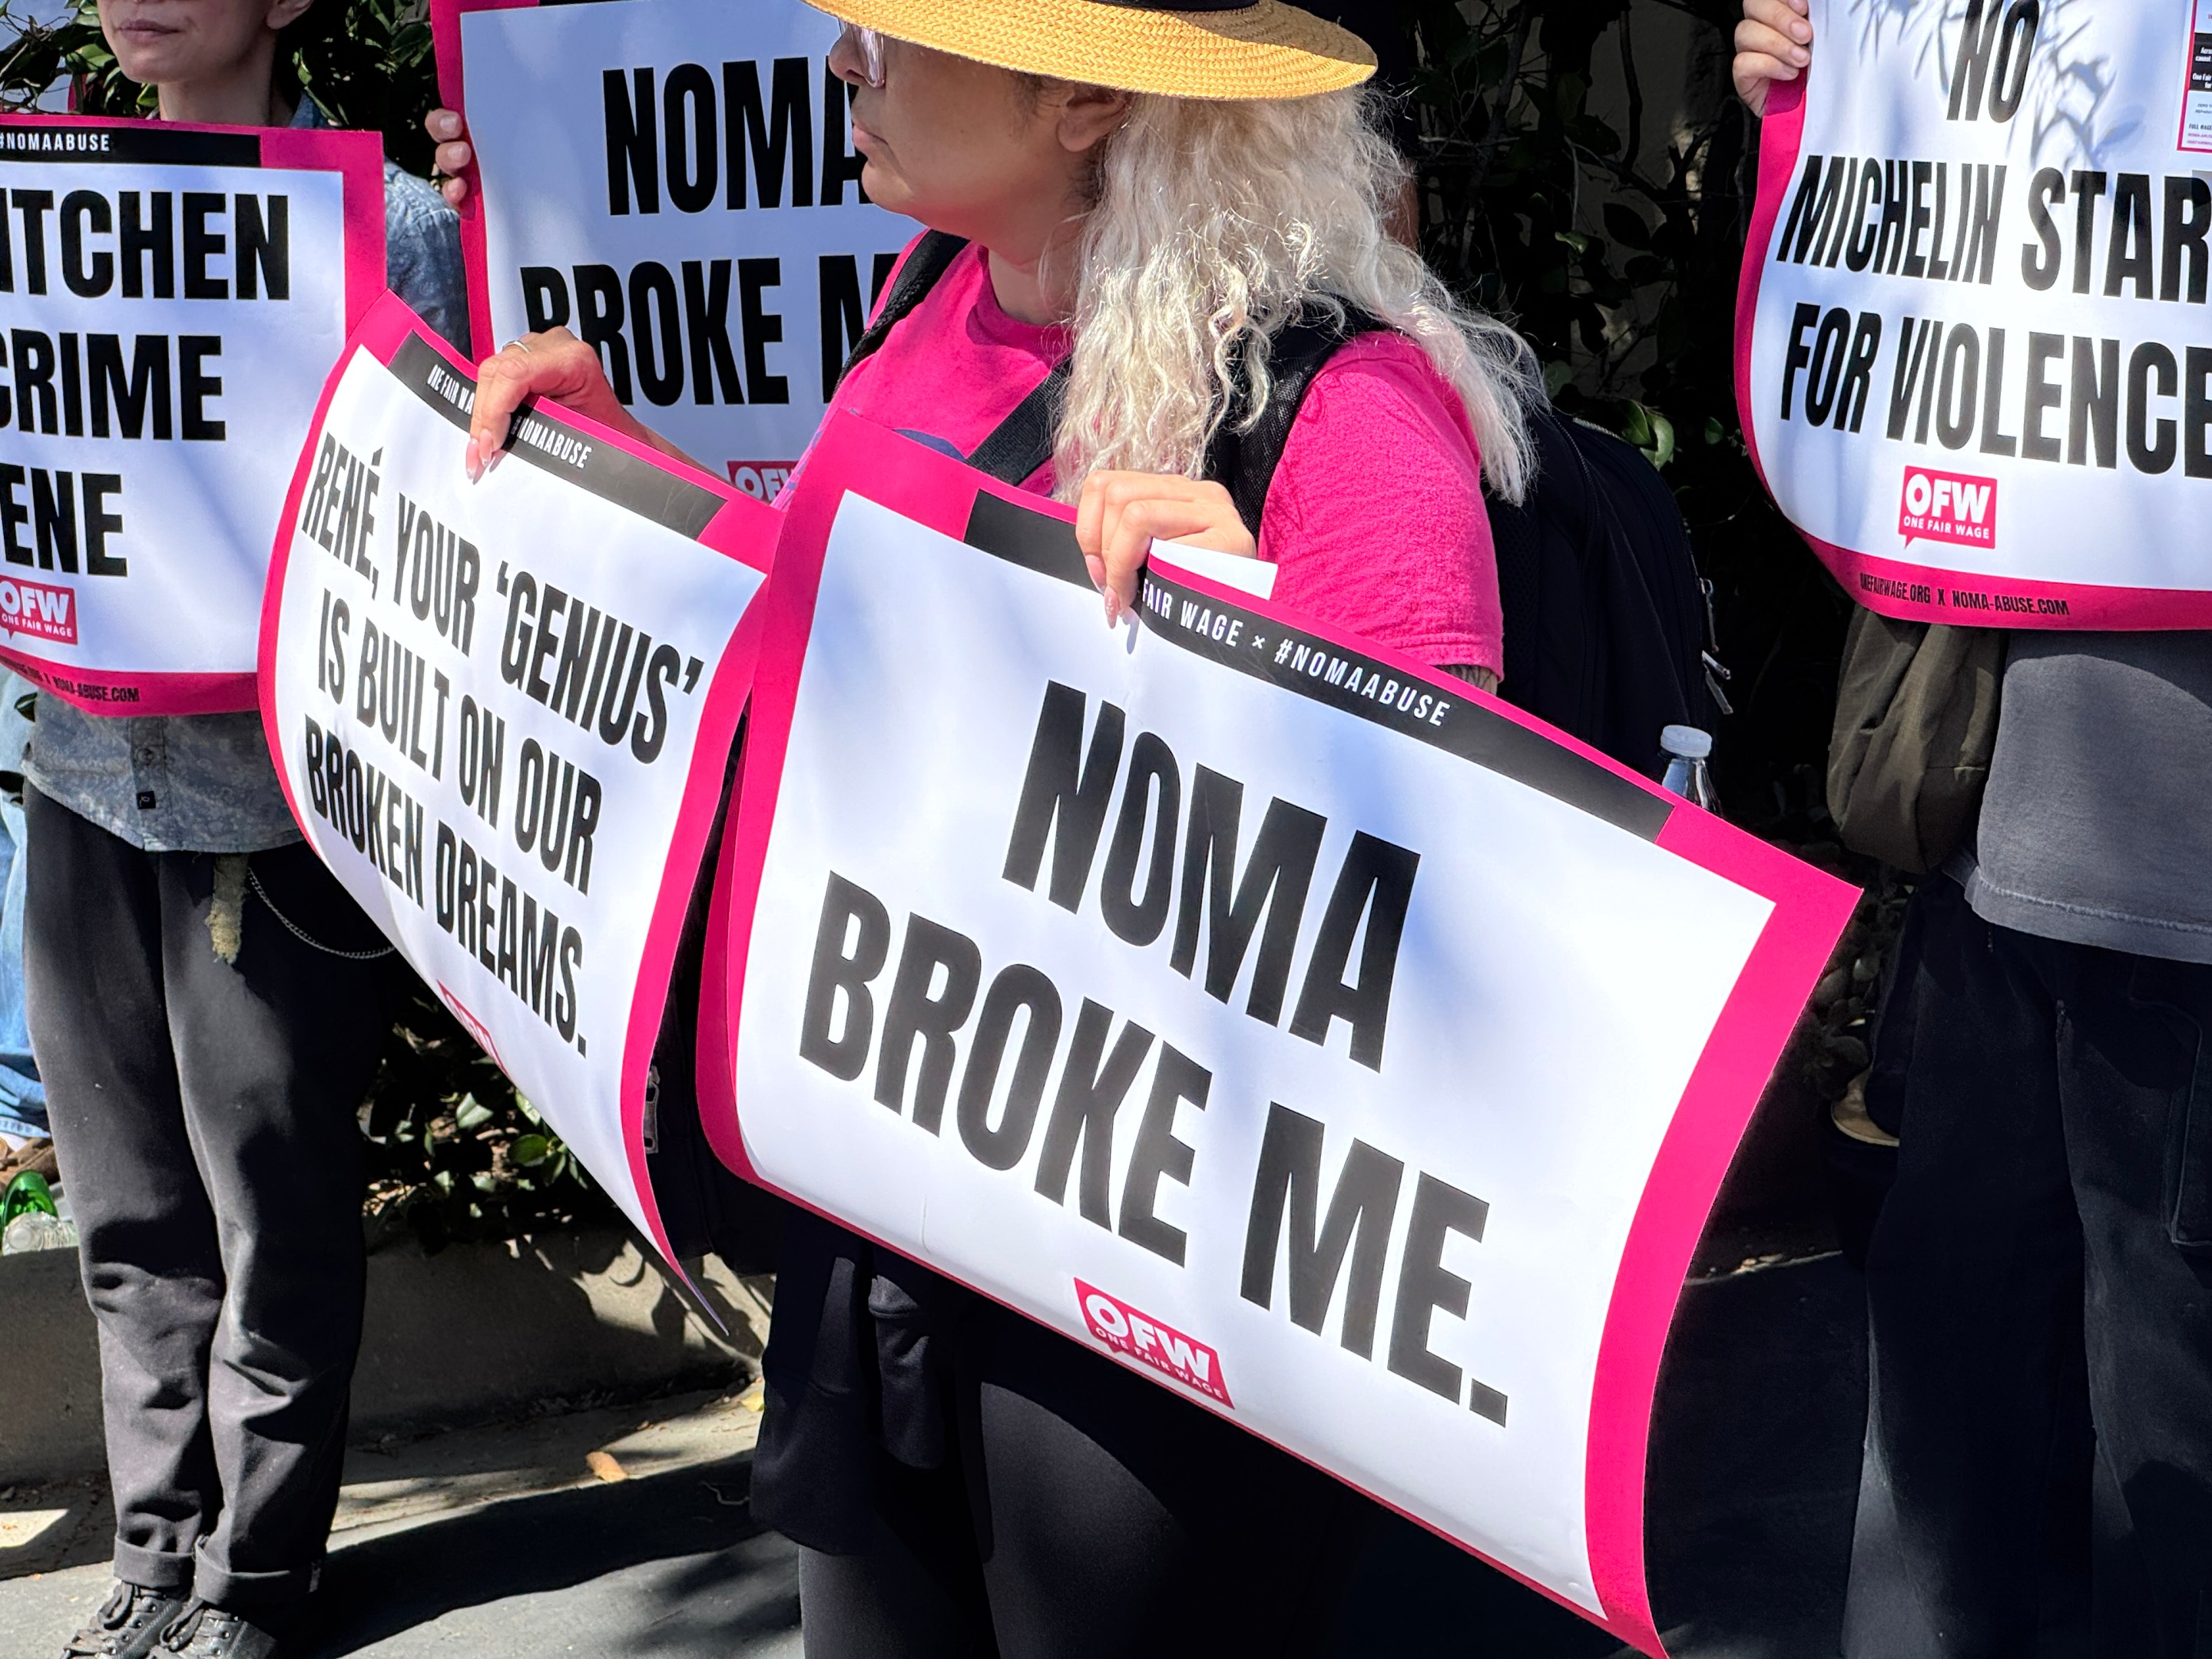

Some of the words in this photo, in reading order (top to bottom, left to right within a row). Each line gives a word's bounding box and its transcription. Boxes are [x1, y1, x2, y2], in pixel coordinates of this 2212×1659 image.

[1946, 0, 2041, 123] NO
[2192, 72, 2202, 81] One
[1776, 155, 2007, 285] MICHELIN
[2021, 167, 2212, 303] STAR
[0, 329, 226, 441] RIME
[427, 364, 445, 392] ONE
[440, 374, 460, 405] FAIR
[510, 416, 592, 469] #NOMAABUSE
[1780, 303, 1883, 434] FOR
[1886, 316, 2212, 479] VIOLENCE
[0, 465, 127, 577] ENE
[735, 466, 794, 502] OF
[1903, 516, 1924, 529] ONE
[1927, 520, 1951, 534] FAIR
[1955, 524, 1989, 539] WAGE
[1906, 474, 1991, 524] OFW
[302, 432, 382, 594] RENÉ,
[393, 492, 479, 657] YOUR
[1859, 572, 1931, 604] ONEFAIRWAGE.ORG
[1938, 588, 1945, 606] X
[1952, 591, 2071, 615] NOMA-ABUSE.COM
[0, 581, 70, 624] OFW
[2, 612, 20, 627] ONE
[22, 618, 42, 632] FAIR
[44, 624, 73, 637] WAGE
[1142, 578, 1173, 620] FAIR
[1180, 600, 1243, 647] WAGE
[1274, 638, 1451, 727] #NOMAABUSE
[317, 588, 349, 706] IS
[356, 615, 450, 782] BUILT
[459, 694, 505, 831] ON
[514, 737, 603, 897] OUR
[304, 713, 425, 911] BROKEN
[437, 819, 586, 1058] DREAMS.
[1002, 679, 1421, 1074] NOMA
[799, 869, 1213, 1268] BROKE
[1240, 1100, 1508, 1429] ME.
[1085, 1293, 1210, 1382] OFW
[1095, 1327, 1128, 1349] ONE
[1134, 1346, 1171, 1372] FAIR
[1175, 1368, 1224, 1399] WAGE
